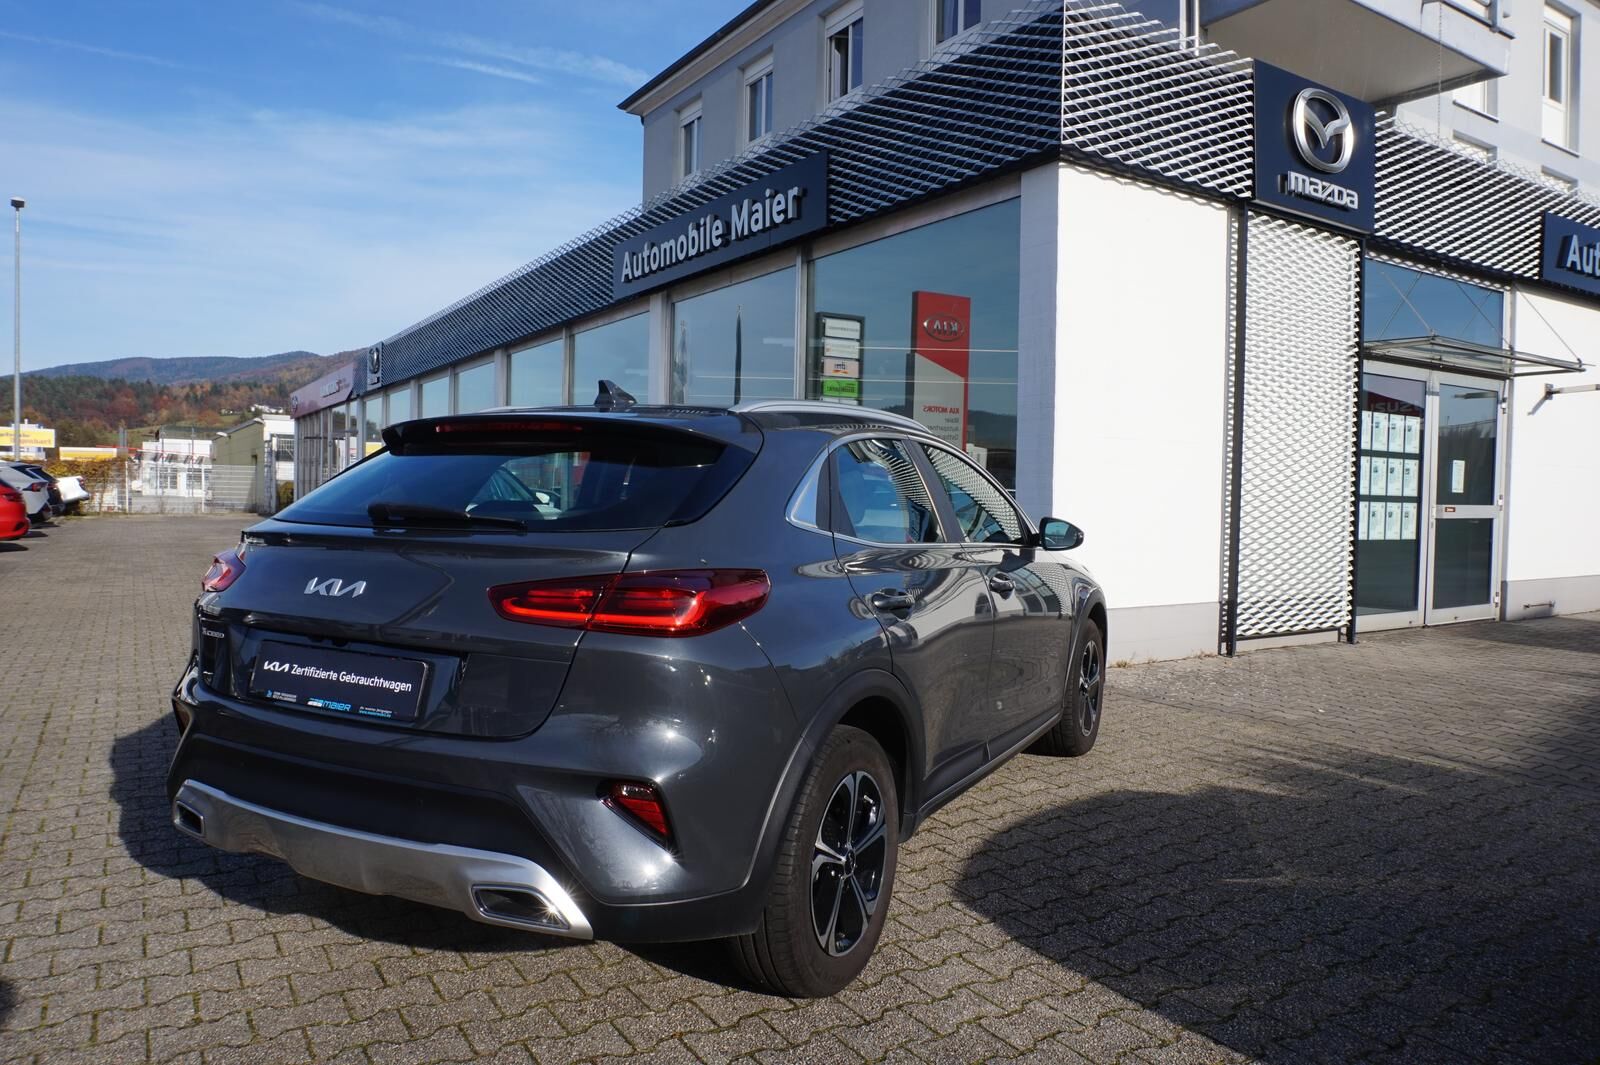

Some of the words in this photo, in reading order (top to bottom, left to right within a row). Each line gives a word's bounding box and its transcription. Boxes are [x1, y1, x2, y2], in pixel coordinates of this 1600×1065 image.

[621, 214, 723, 283] Automobile
[731, 185, 799, 241] Maier
[304, 576, 367, 599] KIA
[263, 660, 290, 673] KIA
[291, 664, 338, 681] Zertifizierte
[339, 671, 412, 693] Gebrauchtwagen
